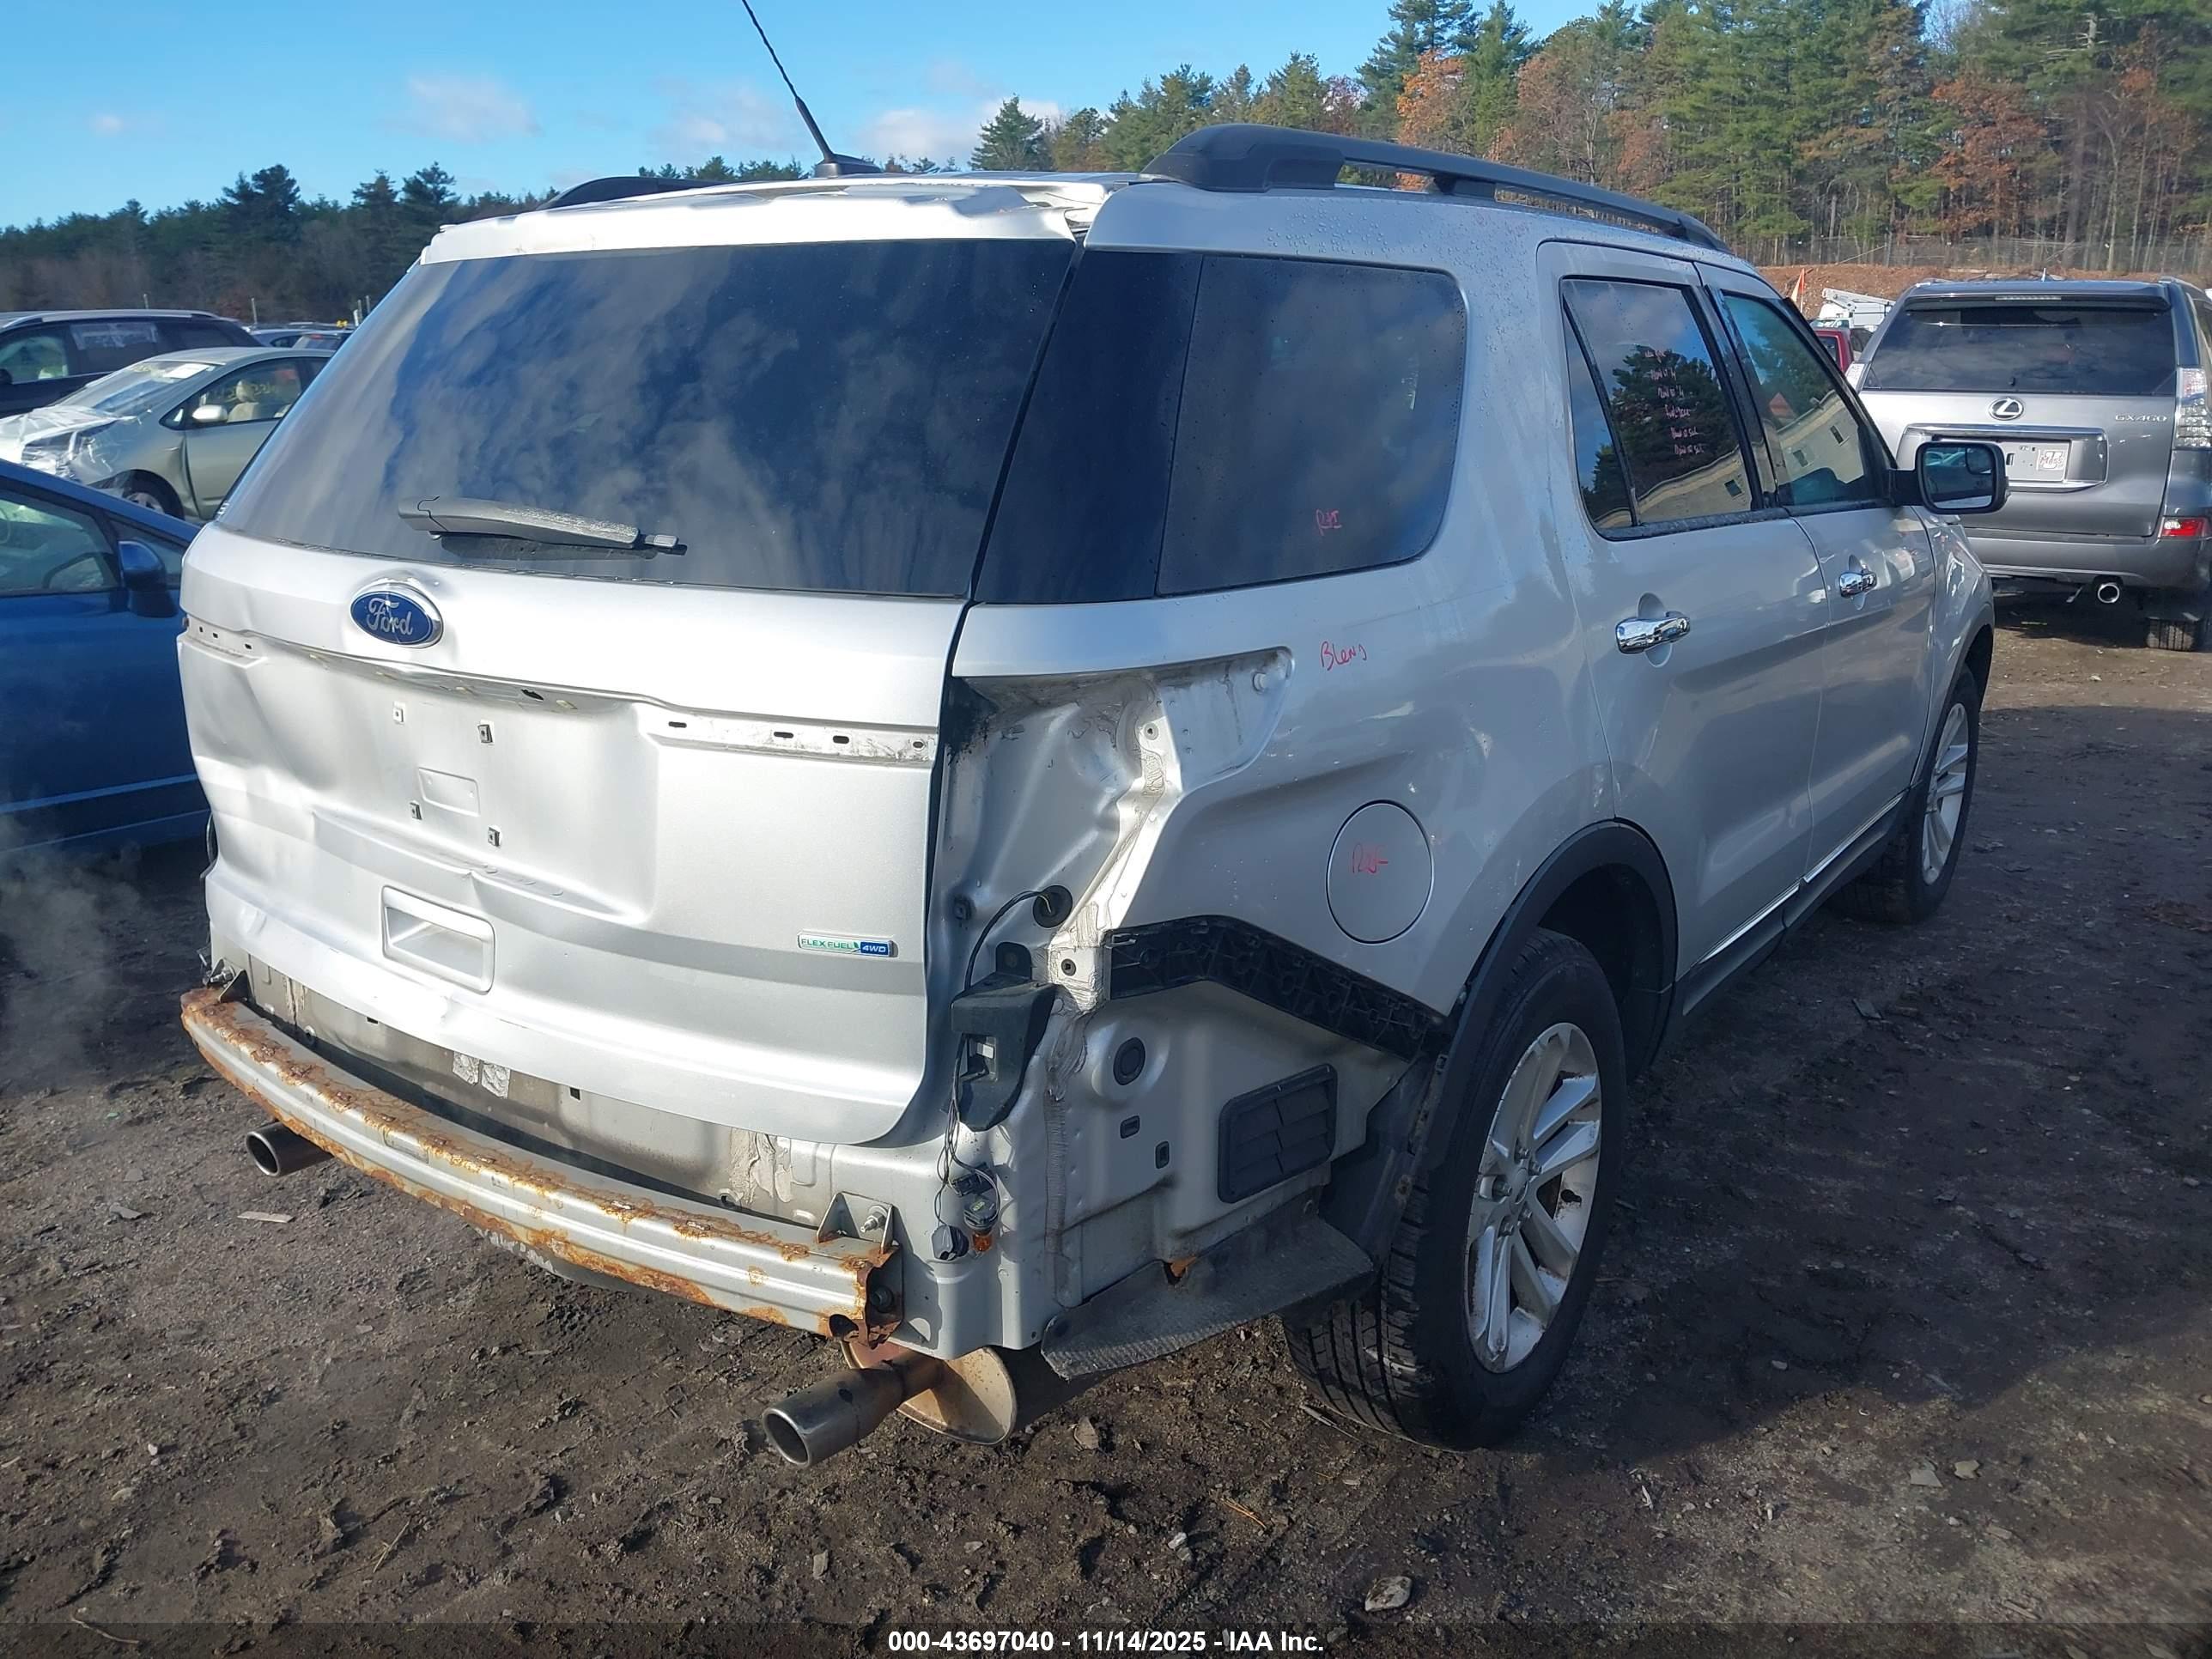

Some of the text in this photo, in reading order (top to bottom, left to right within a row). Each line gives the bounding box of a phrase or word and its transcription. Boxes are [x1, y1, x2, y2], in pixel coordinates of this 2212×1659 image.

[2115, 414, 2165, 422] GX460
[367, 597, 414, 635] Ford
[800, 938, 887, 954] FLEX FUEL 4WD
